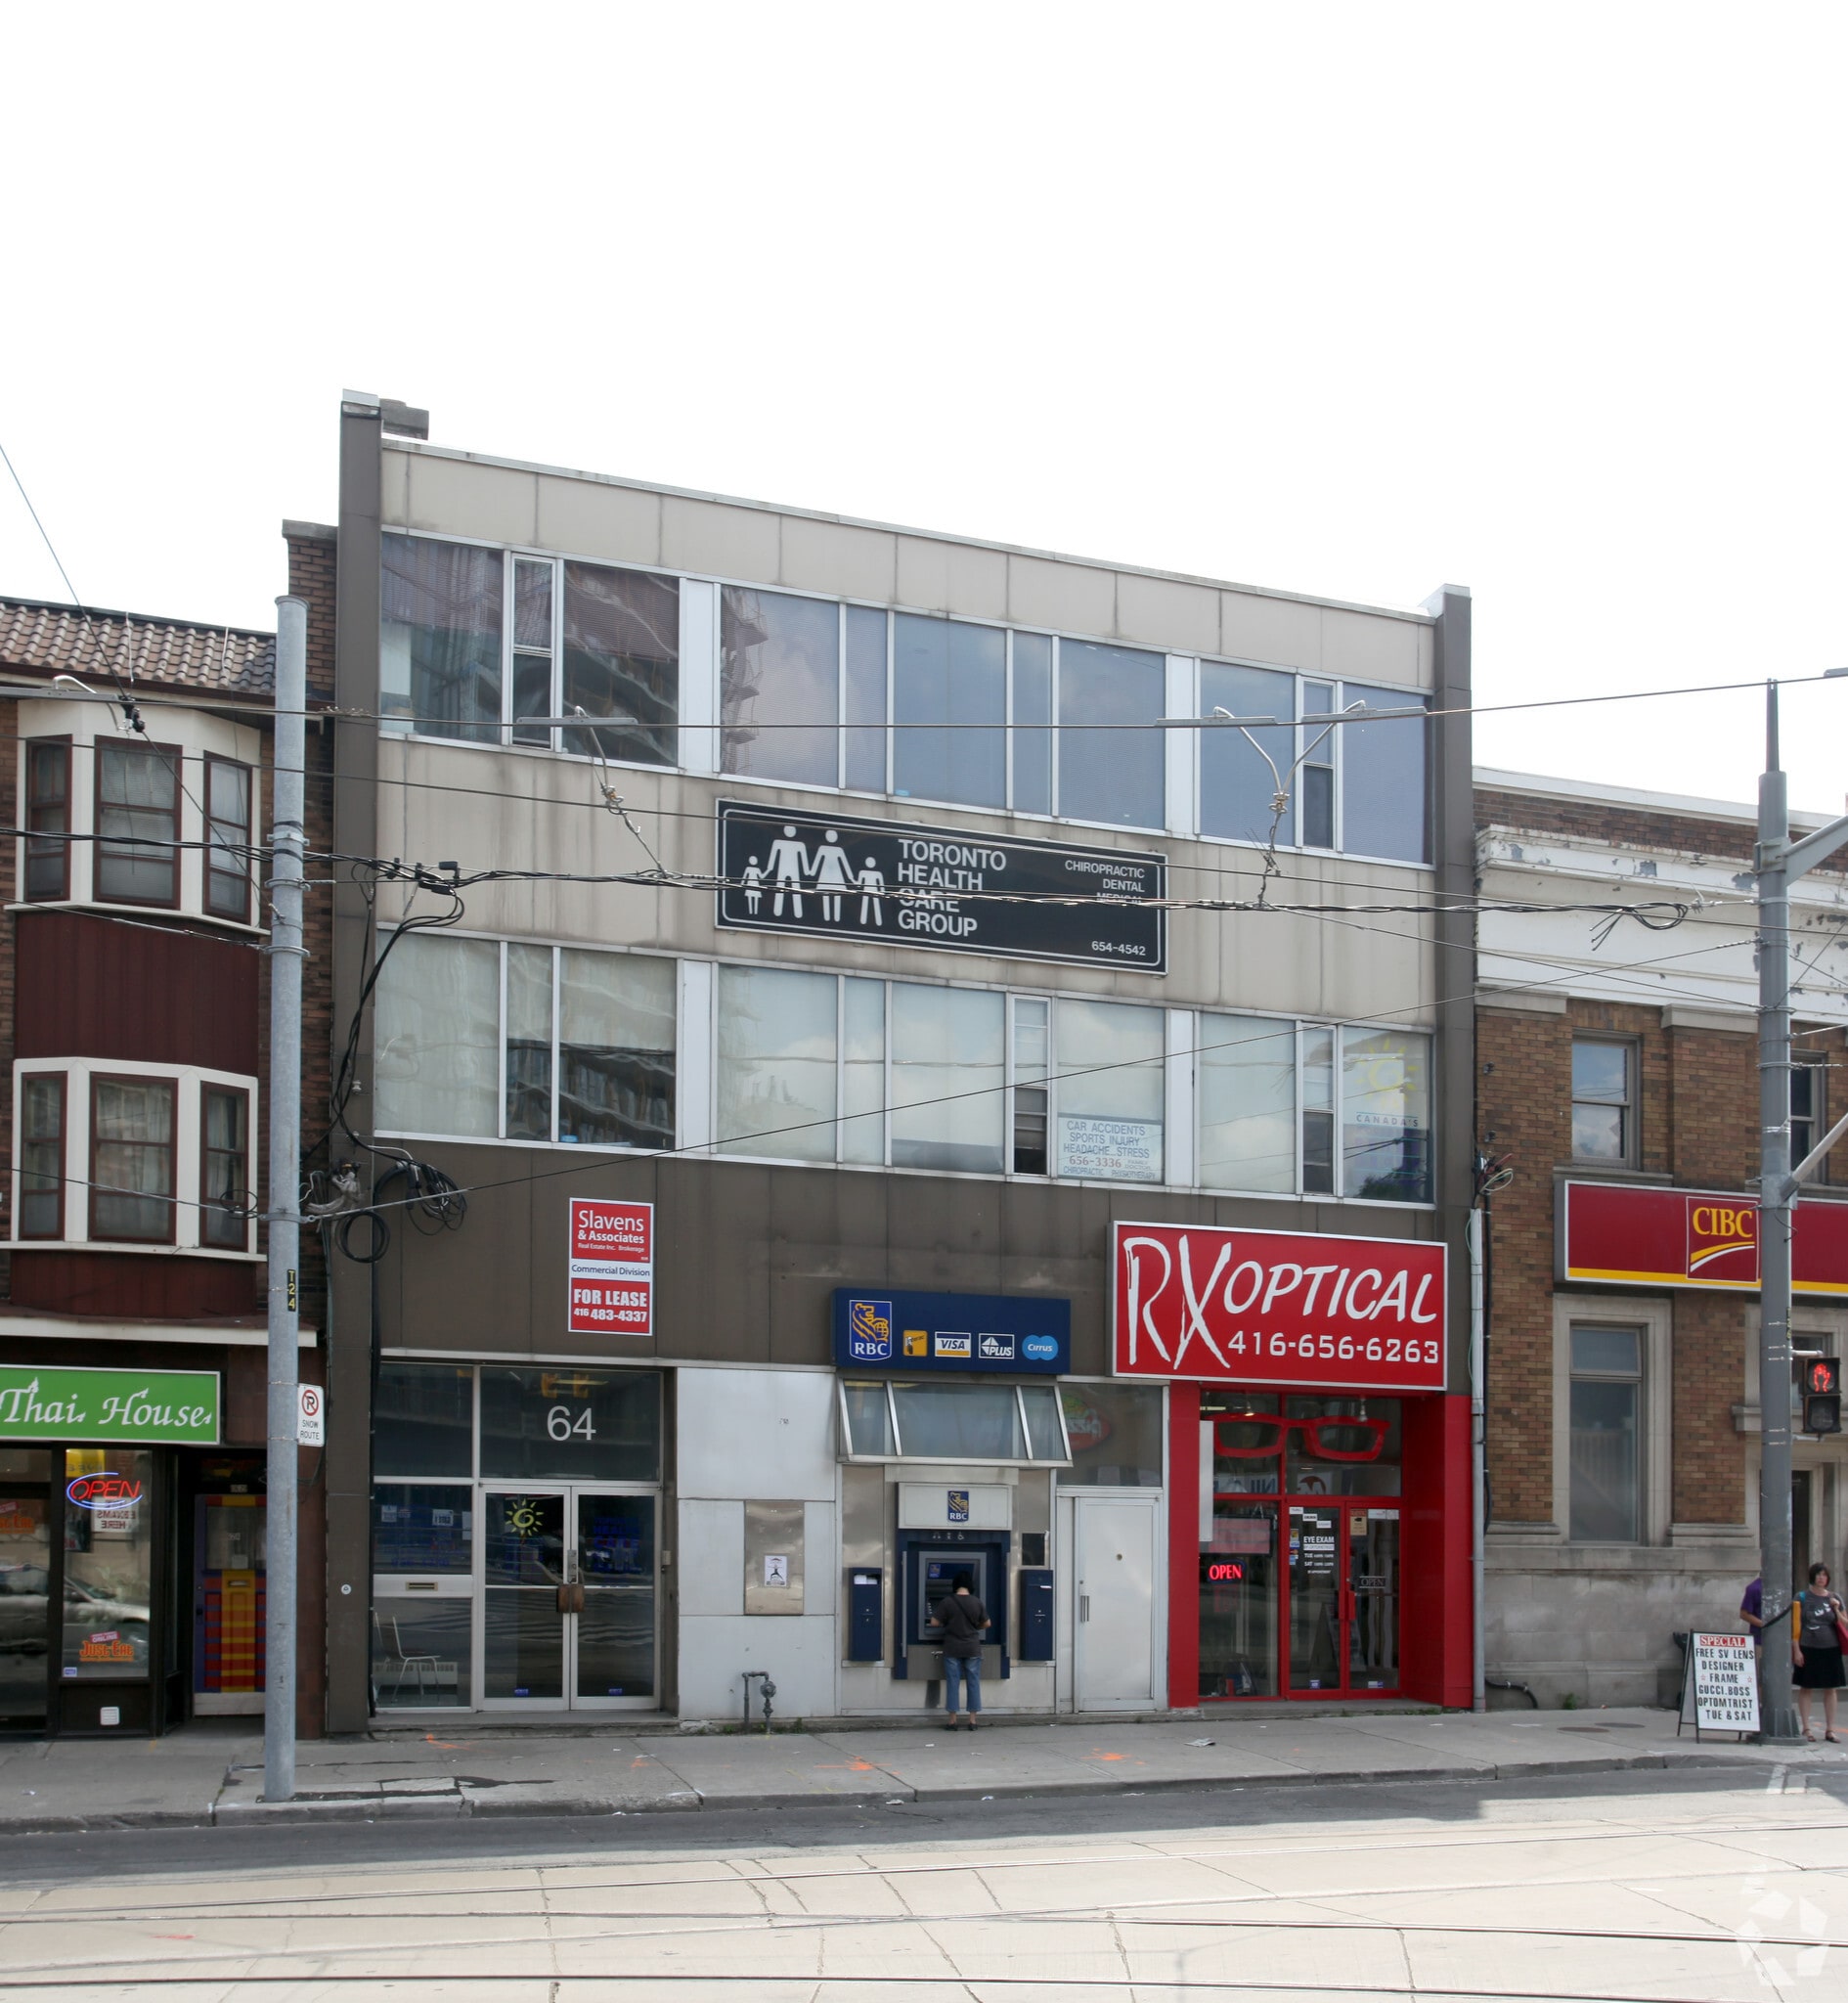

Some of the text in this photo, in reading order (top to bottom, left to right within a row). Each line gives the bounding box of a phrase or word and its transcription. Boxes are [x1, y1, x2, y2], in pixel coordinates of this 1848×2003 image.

[898, 838, 1007, 871] TORONTO
[898, 862, 983, 891] HEALTH
[1064, 860, 1145, 879] CHIROPRACTIC
[1102, 878, 1145, 893] DENTAL
[898, 909, 978, 937] GROUP
[1091, 940, 1146, 957] 654-4542
[1067, 1120, 1146, 1136] CAR ACCIDENTS
[1356, 1114, 1419, 1128] CANADA'S
[1070, 1132, 1140, 1147] SPORTS INJURY
[1117, 1146, 1150, 1159] STRESS
[1069, 1155, 1122, 1169] 656-3336
[578, 1210, 644, 1232] Slavens
[1693, 1207, 1753, 1238] CIBC
[578, 1229, 644, 1244] & Associates
[571, 1265, 650, 1277] Commercial Division
[574, 1288, 647, 1308] FOR LEASE
[1224, 1260, 1436, 1323] OPTICAL
[574, 1308, 647, 1322] 416 483-4337
[855, 1342, 888, 1356] RBC
[941, 1339, 966, 1350] VISA
[990, 1347, 1013, 1357] PLUS
[1228, 1331, 1439, 1364] 416-656-6263
[0, 1377, 212, 1427] Thai House
[302, 1419, 319, 1429] SNOW
[547, 1405, 596, 1441] 64
[300, 1430, 320, 1441] ROUTE
[70, 1480, 141, 1499] OPEN
[1209, 1564, 1243, 1580] OPEN
[1700, 1635, 1745, 1647] SPECIAL
[1695, 1648, 1754, 1660] FREE SV LENS
[1701, 1661, 1745, 1671] DESIGNER
[1709, 1673, 1738, 1684] FRAME
[1697, 1697, 1753, 1709] OPTOMTRIST
[1706, 1710, 1722, 1719] TUE
